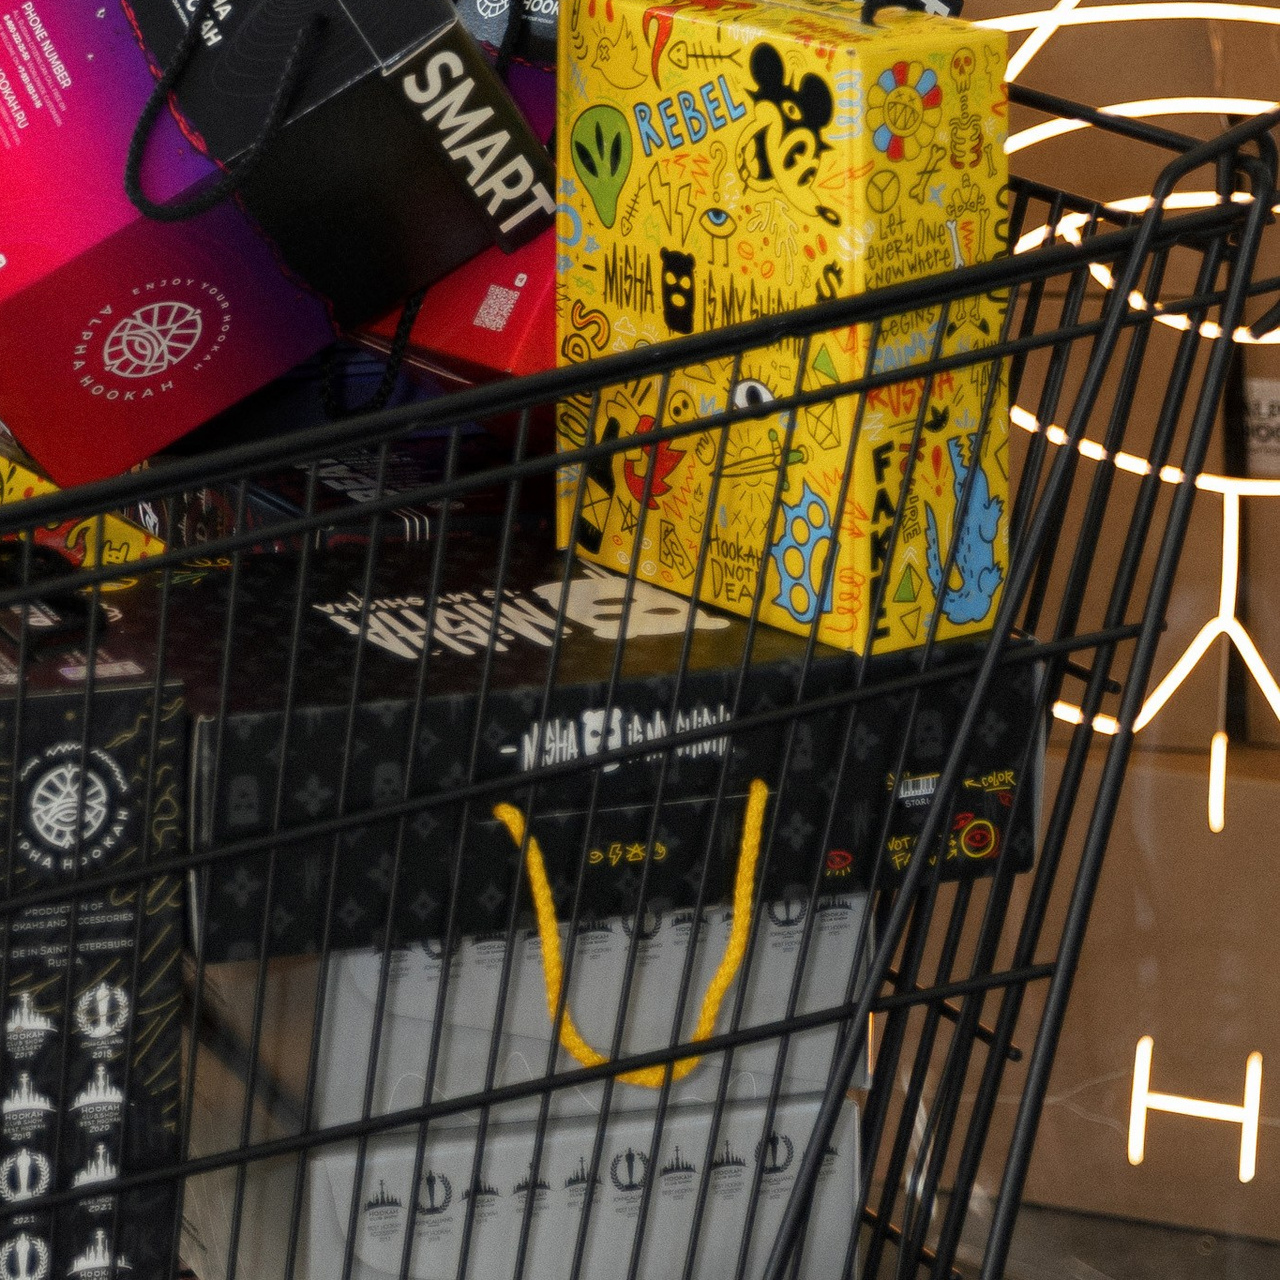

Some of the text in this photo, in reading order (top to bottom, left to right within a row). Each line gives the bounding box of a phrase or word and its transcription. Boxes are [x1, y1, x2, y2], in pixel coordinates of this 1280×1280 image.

[21, 2, 72, 89] PHONE NUMBER
[403, 50, 556, 234] SMART
[633, 73, 747, 157] REBEL
[73, 304, 174, 401] ALPHA HOOKAH
[132, 278, 231, 371] ENJOY YOUR HOOKAH
[77, 912, 134, 927] CCESSORIES
[77, 938, 134, 952] ETERSBURG
